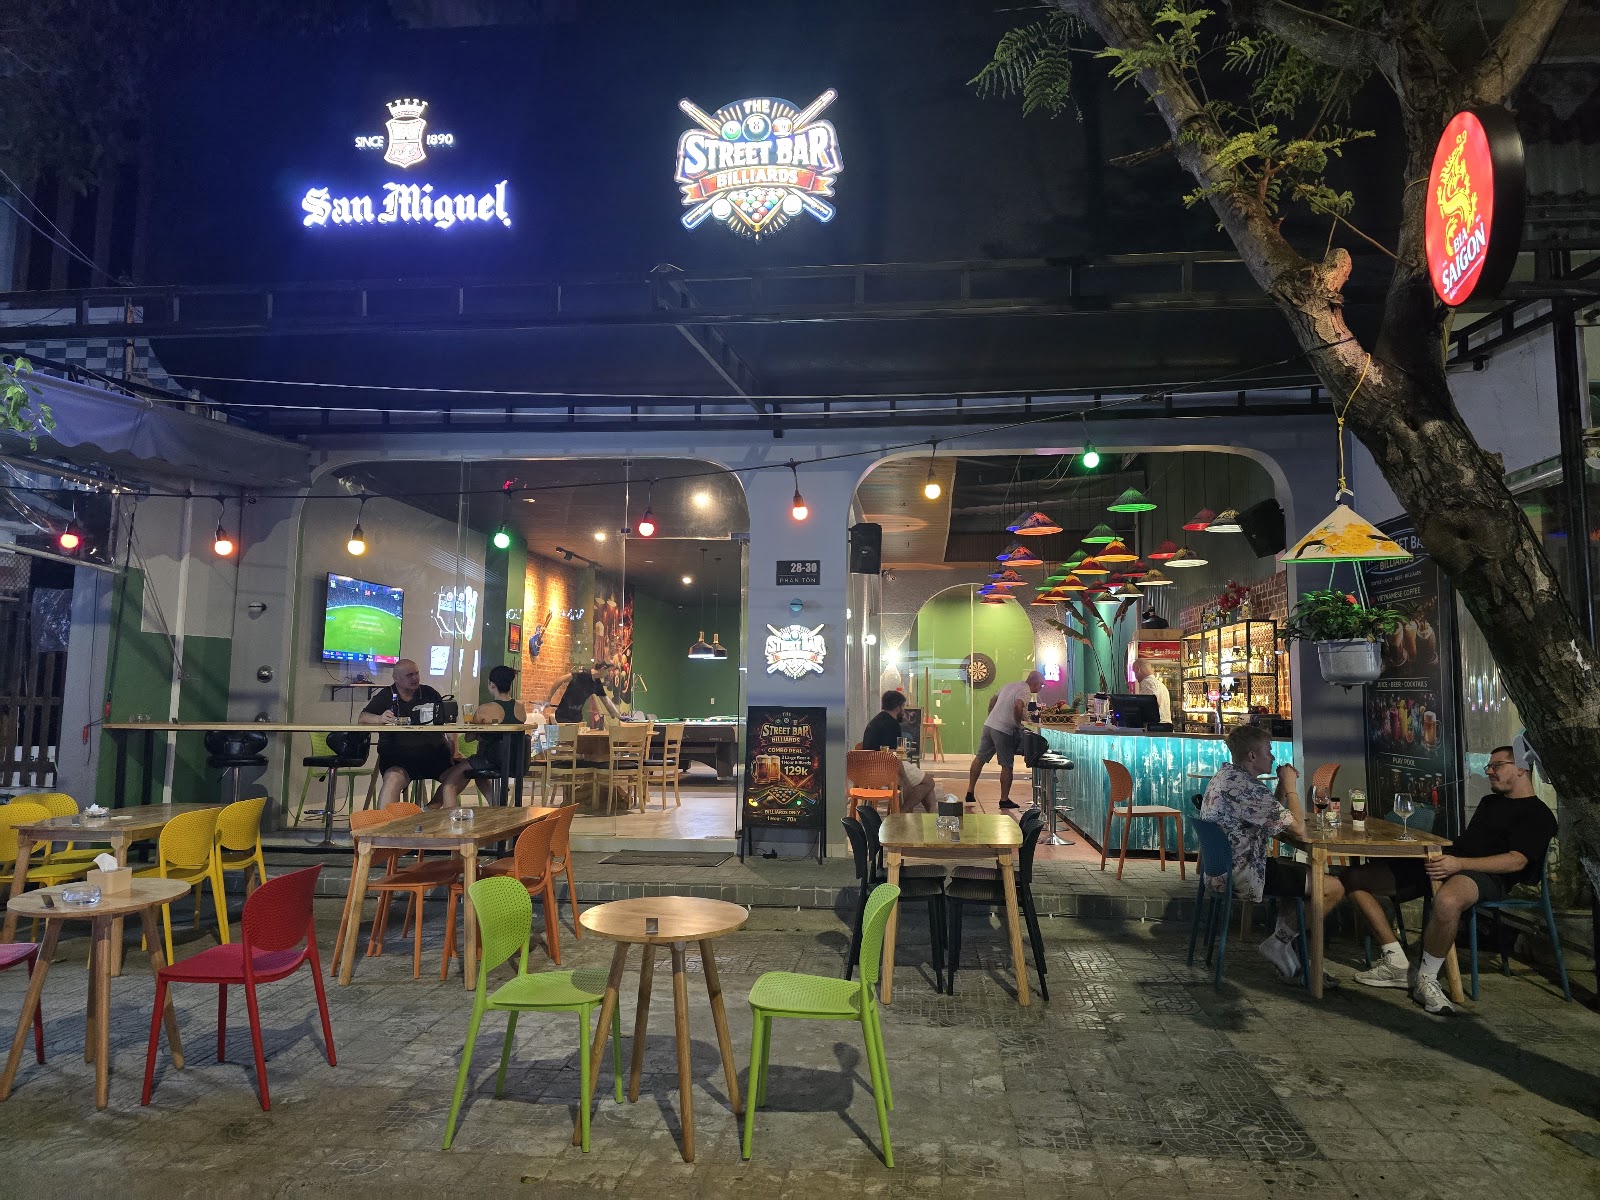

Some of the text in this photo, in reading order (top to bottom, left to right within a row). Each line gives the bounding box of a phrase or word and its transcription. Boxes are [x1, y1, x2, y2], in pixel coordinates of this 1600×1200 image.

[743, 99, 771, 114] THE
[354, 135, 384, 149] SINCE
[426, 133, 453, 146] 1890
[684, 128, 834, 175] STREET BAR
[716, 168, 799, 188] BILLIARDS
[302, 180, 512, 230] San Miguel
[1453, 227, 1469, 254] BIA
[1442, 221, 1487, 295] SAIGON
[790, 562, 818, 573] 28-30
[1377, 586, 1421, 602] VIETNAMESE COFFEE
[763, 725, 810, 738] STREET BAR
[784, 766, 808, 776] 129k
